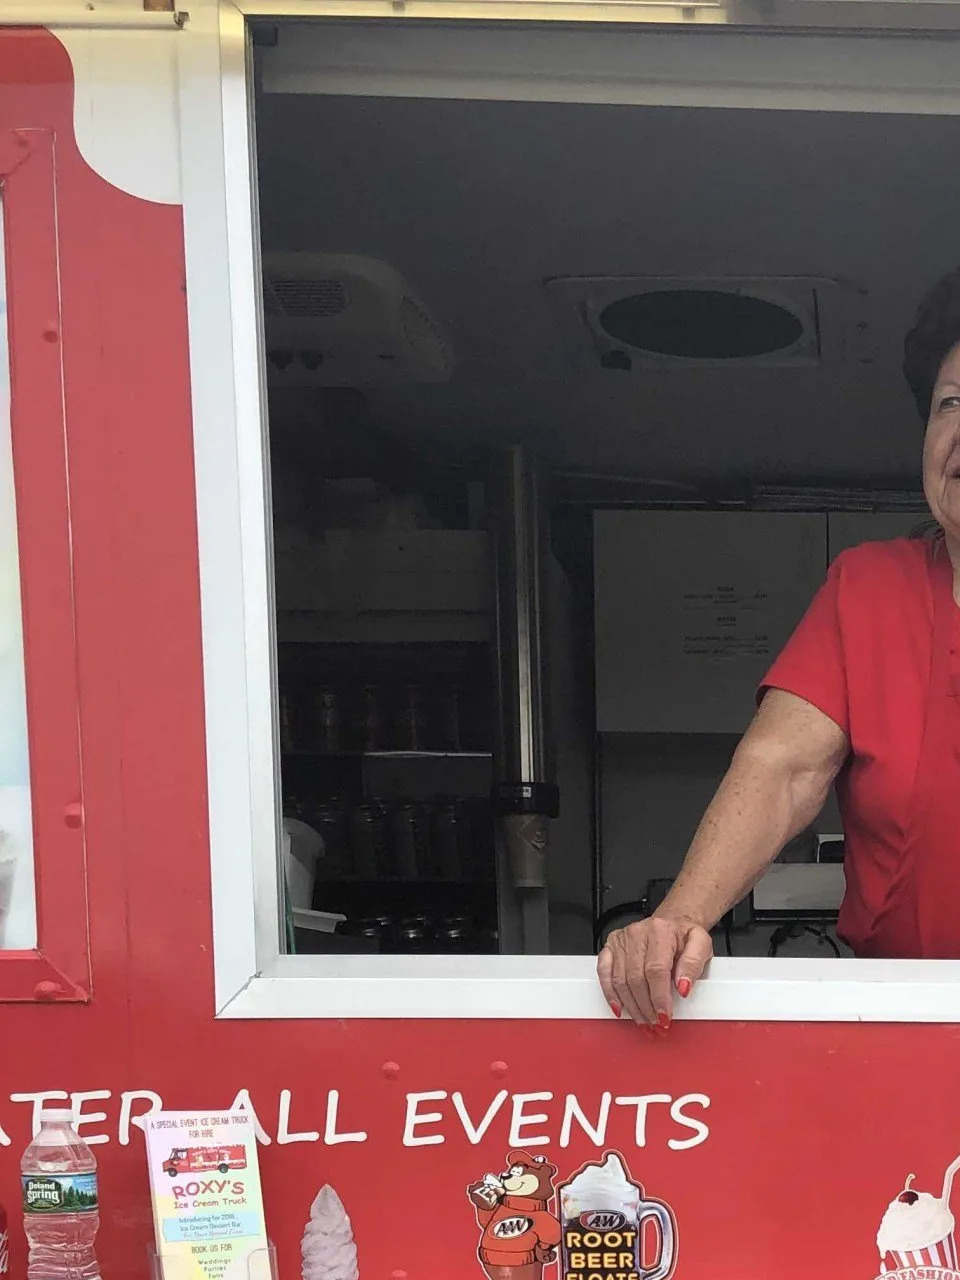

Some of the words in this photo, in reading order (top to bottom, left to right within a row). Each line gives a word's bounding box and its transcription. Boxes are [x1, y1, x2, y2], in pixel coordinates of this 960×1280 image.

[0, 1090, 163, 1146] TER
[403, 1090, 710, 1150] EVENTS
[180, 1119, 197, 1127] EVENT
[231, 1116, 248, 1124] TRUCK
[29, 1181, 55, 1190] Poland
[27, 1190, 60, 1203] Spring
[222, 1197, 247, 1205] Truck
[495, 1217, 527, 1234] A&W
[566, 1232, 636, 1248] ROOT
[191, 1246, 207, 1254] BOOK
[571, 1253, 633, 1268] BEER
